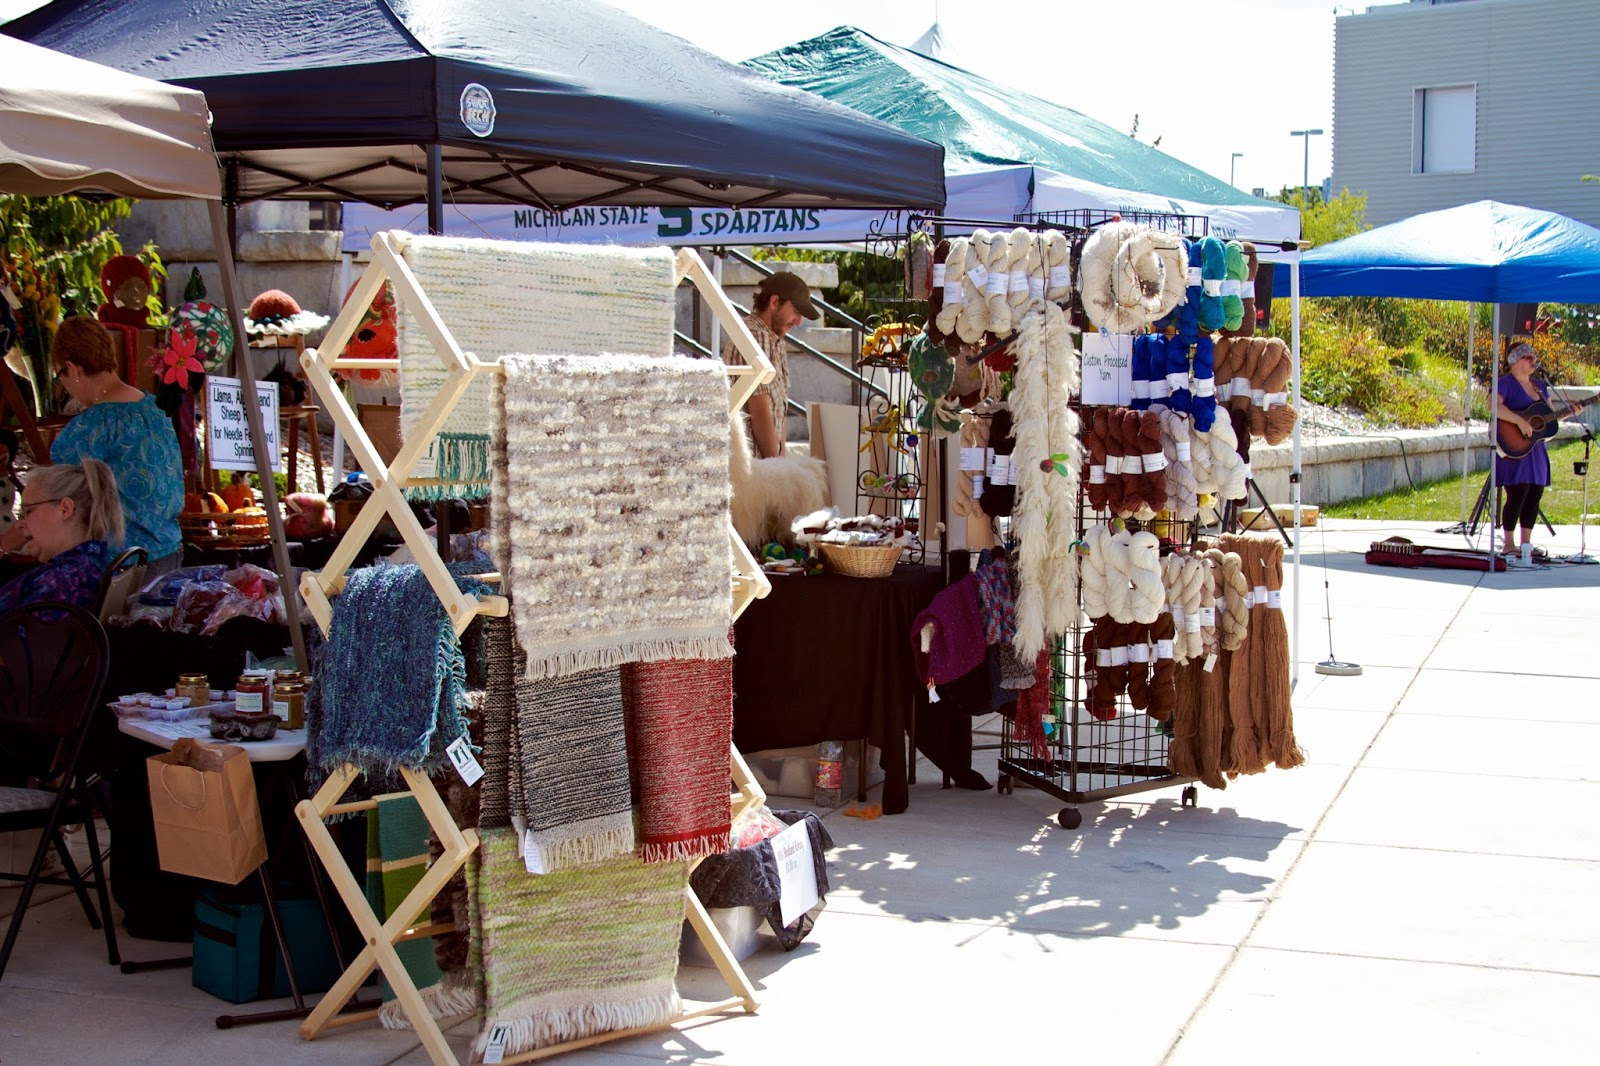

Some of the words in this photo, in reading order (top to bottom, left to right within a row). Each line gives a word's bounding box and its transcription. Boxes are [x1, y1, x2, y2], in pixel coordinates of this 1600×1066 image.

[466, 108, 489, 123] TECH
[514, 208, 595, 229] MICHIGAN
[599, 206, 649, 226] STATE
[699, 208, 821, 236] SPARTANS
[1083, 352, 1102, 367] Custom
[1103, 353, 1129, 368] Processed
[1098, 367, 1112, 381] Yarn
[213, 387, 234, 406] Llama,
[259, 393, 271, 407] and
[221, 405, 241, 425] Sheep
[223, 426, 243, 441] Needle
